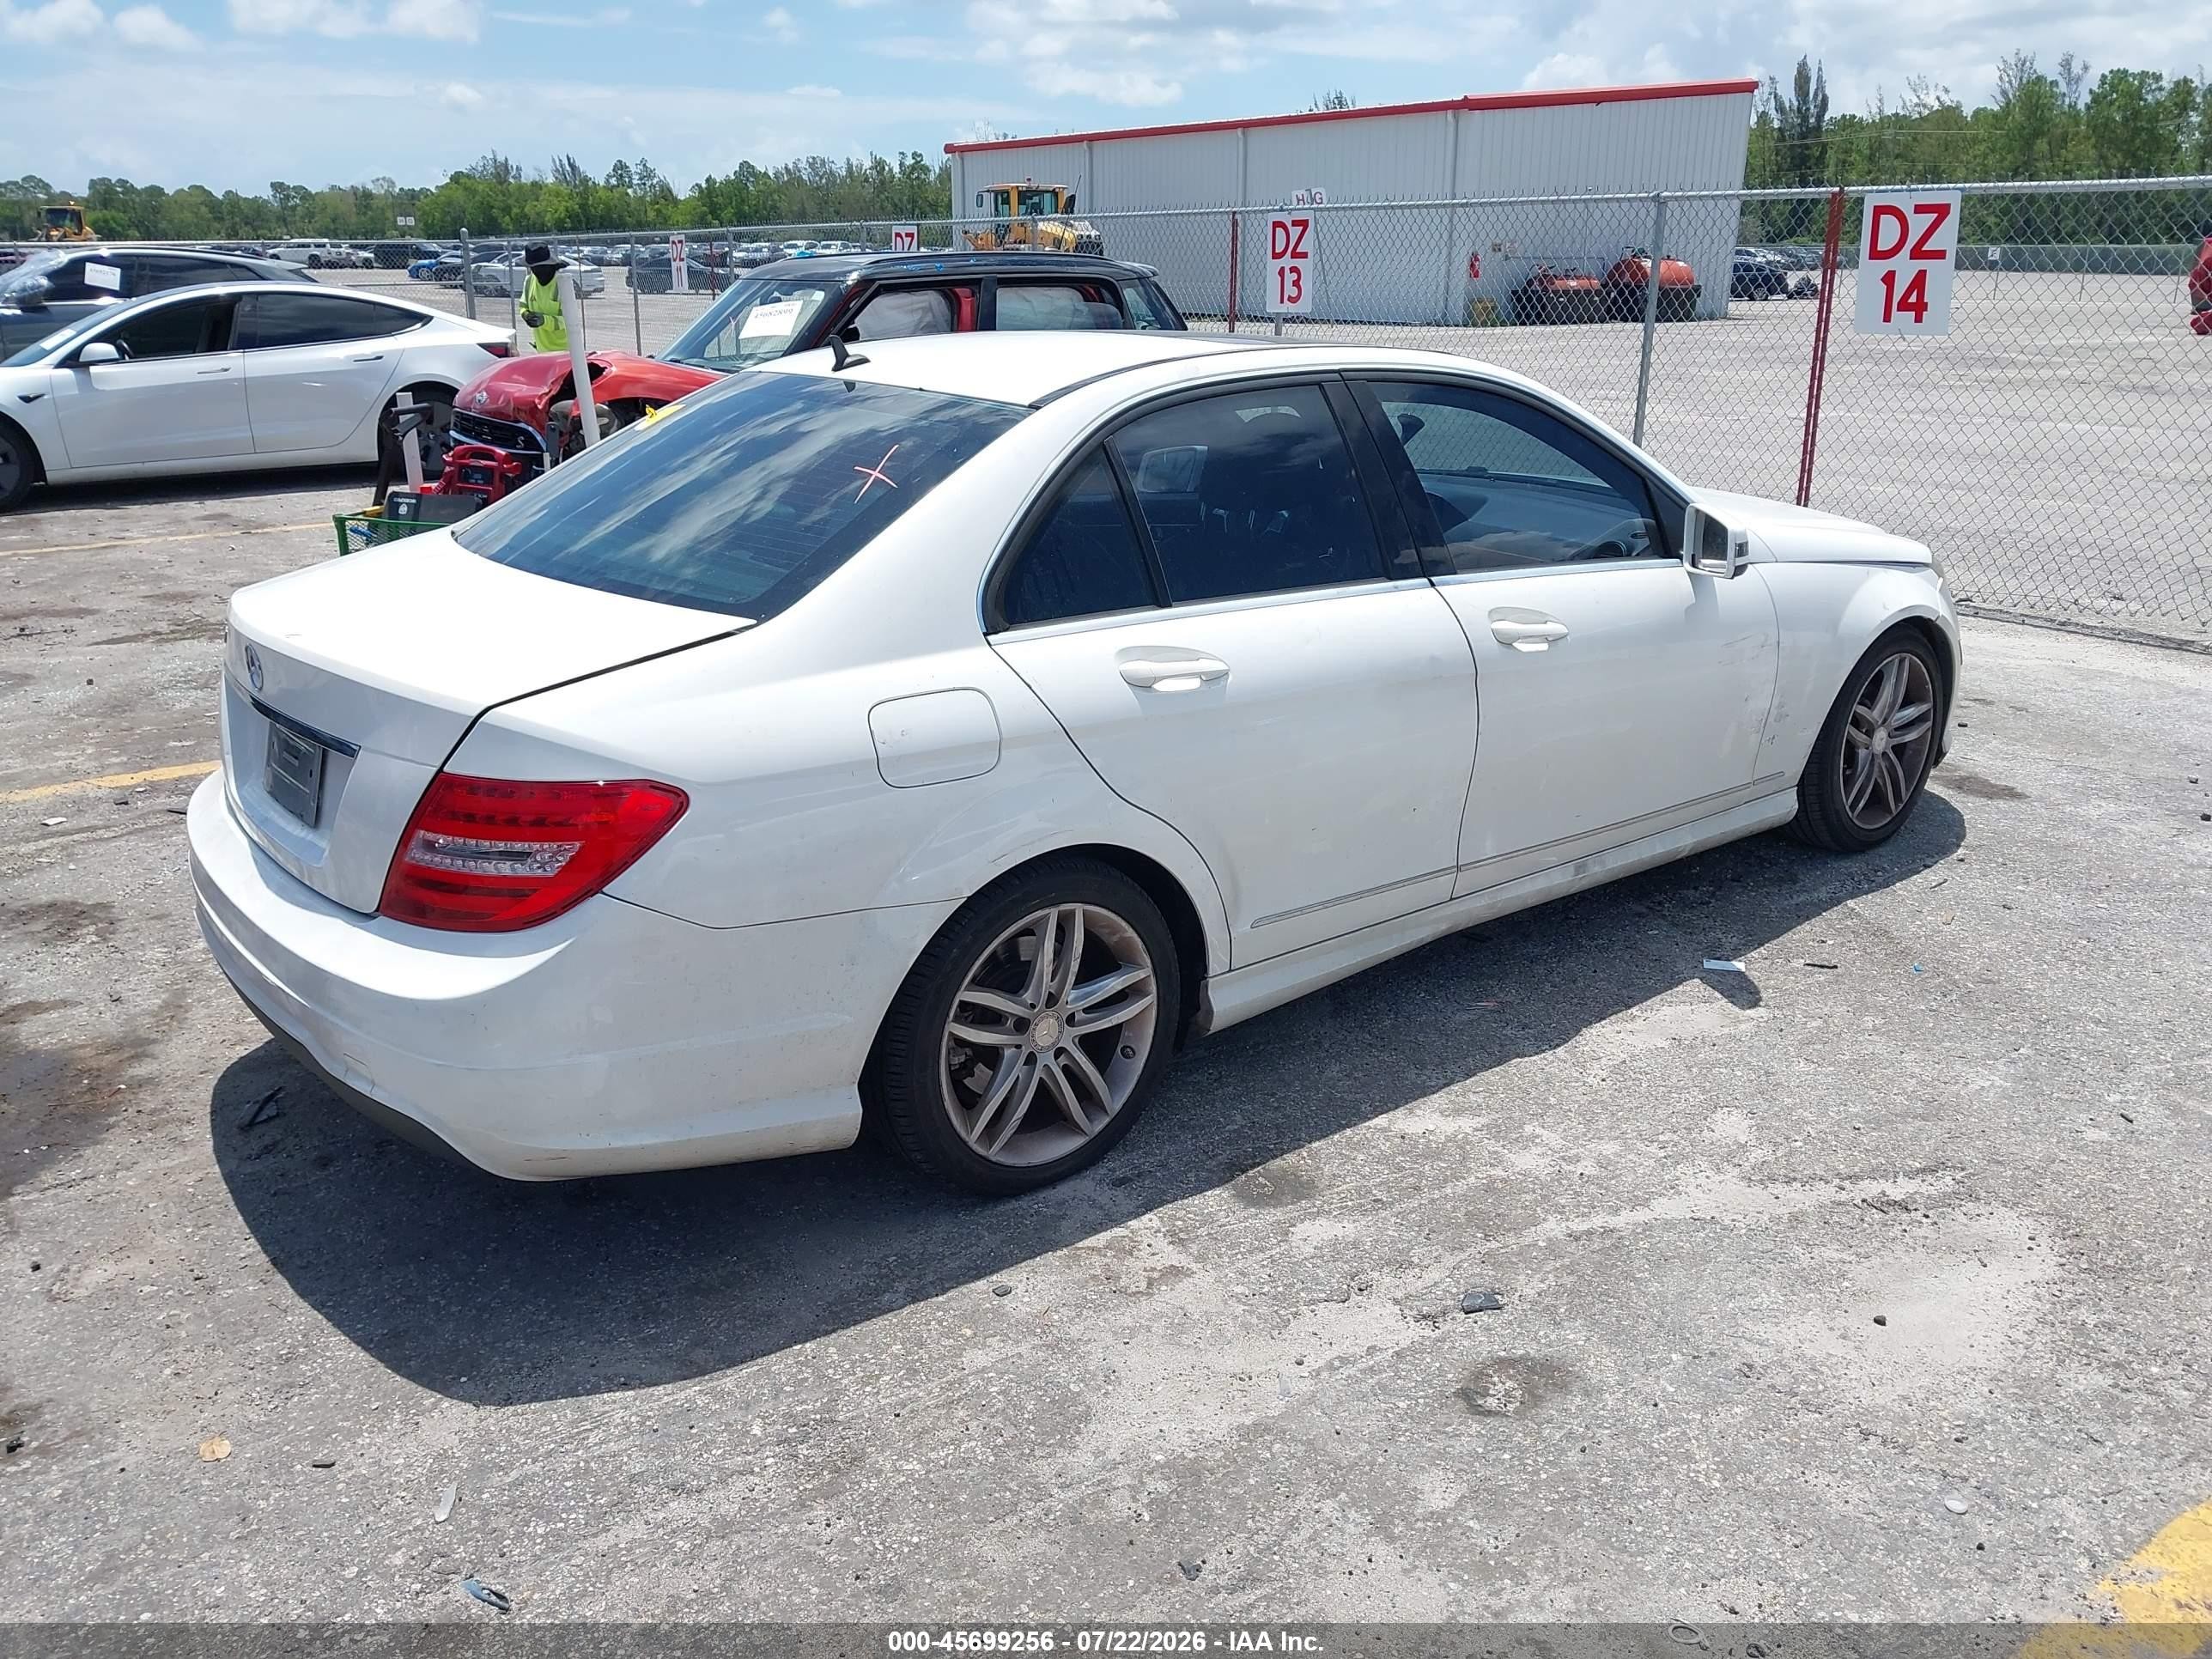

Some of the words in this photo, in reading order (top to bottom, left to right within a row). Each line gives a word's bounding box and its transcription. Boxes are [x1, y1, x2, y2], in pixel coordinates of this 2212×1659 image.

[672, 240, 684, 262] DZ
[1272, 219, 1310, 260] DZ
[1869, 204, 1951, 260] DZ
[677, 265, 683, 287] 11
[1278, 265, 1303, 304] 13
[1881, 270, 1928, 323] 14
